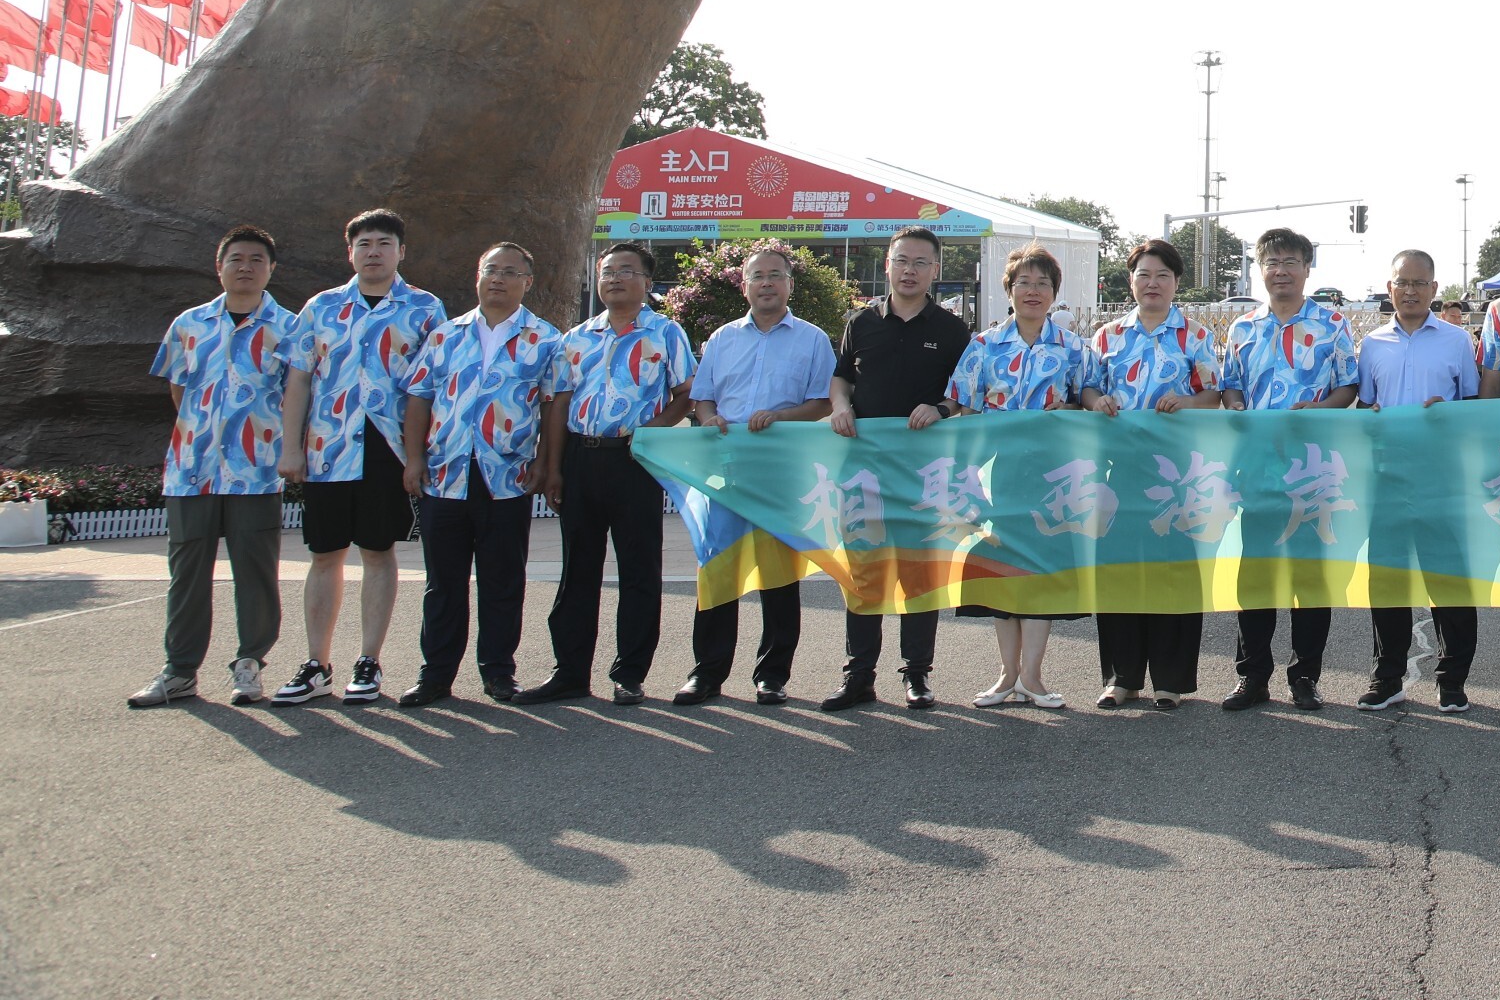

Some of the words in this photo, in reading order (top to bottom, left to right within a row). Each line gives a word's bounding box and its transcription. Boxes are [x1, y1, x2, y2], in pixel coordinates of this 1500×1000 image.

[659, 149, 729, 172] 主入口
[668, 175, 690, 183] MAIN
[691, 175, 718, 183] ENTRY
[671, 193, 742, 208] 游客安检口
[798, 442, 1359, 551] 相聚西海岸
